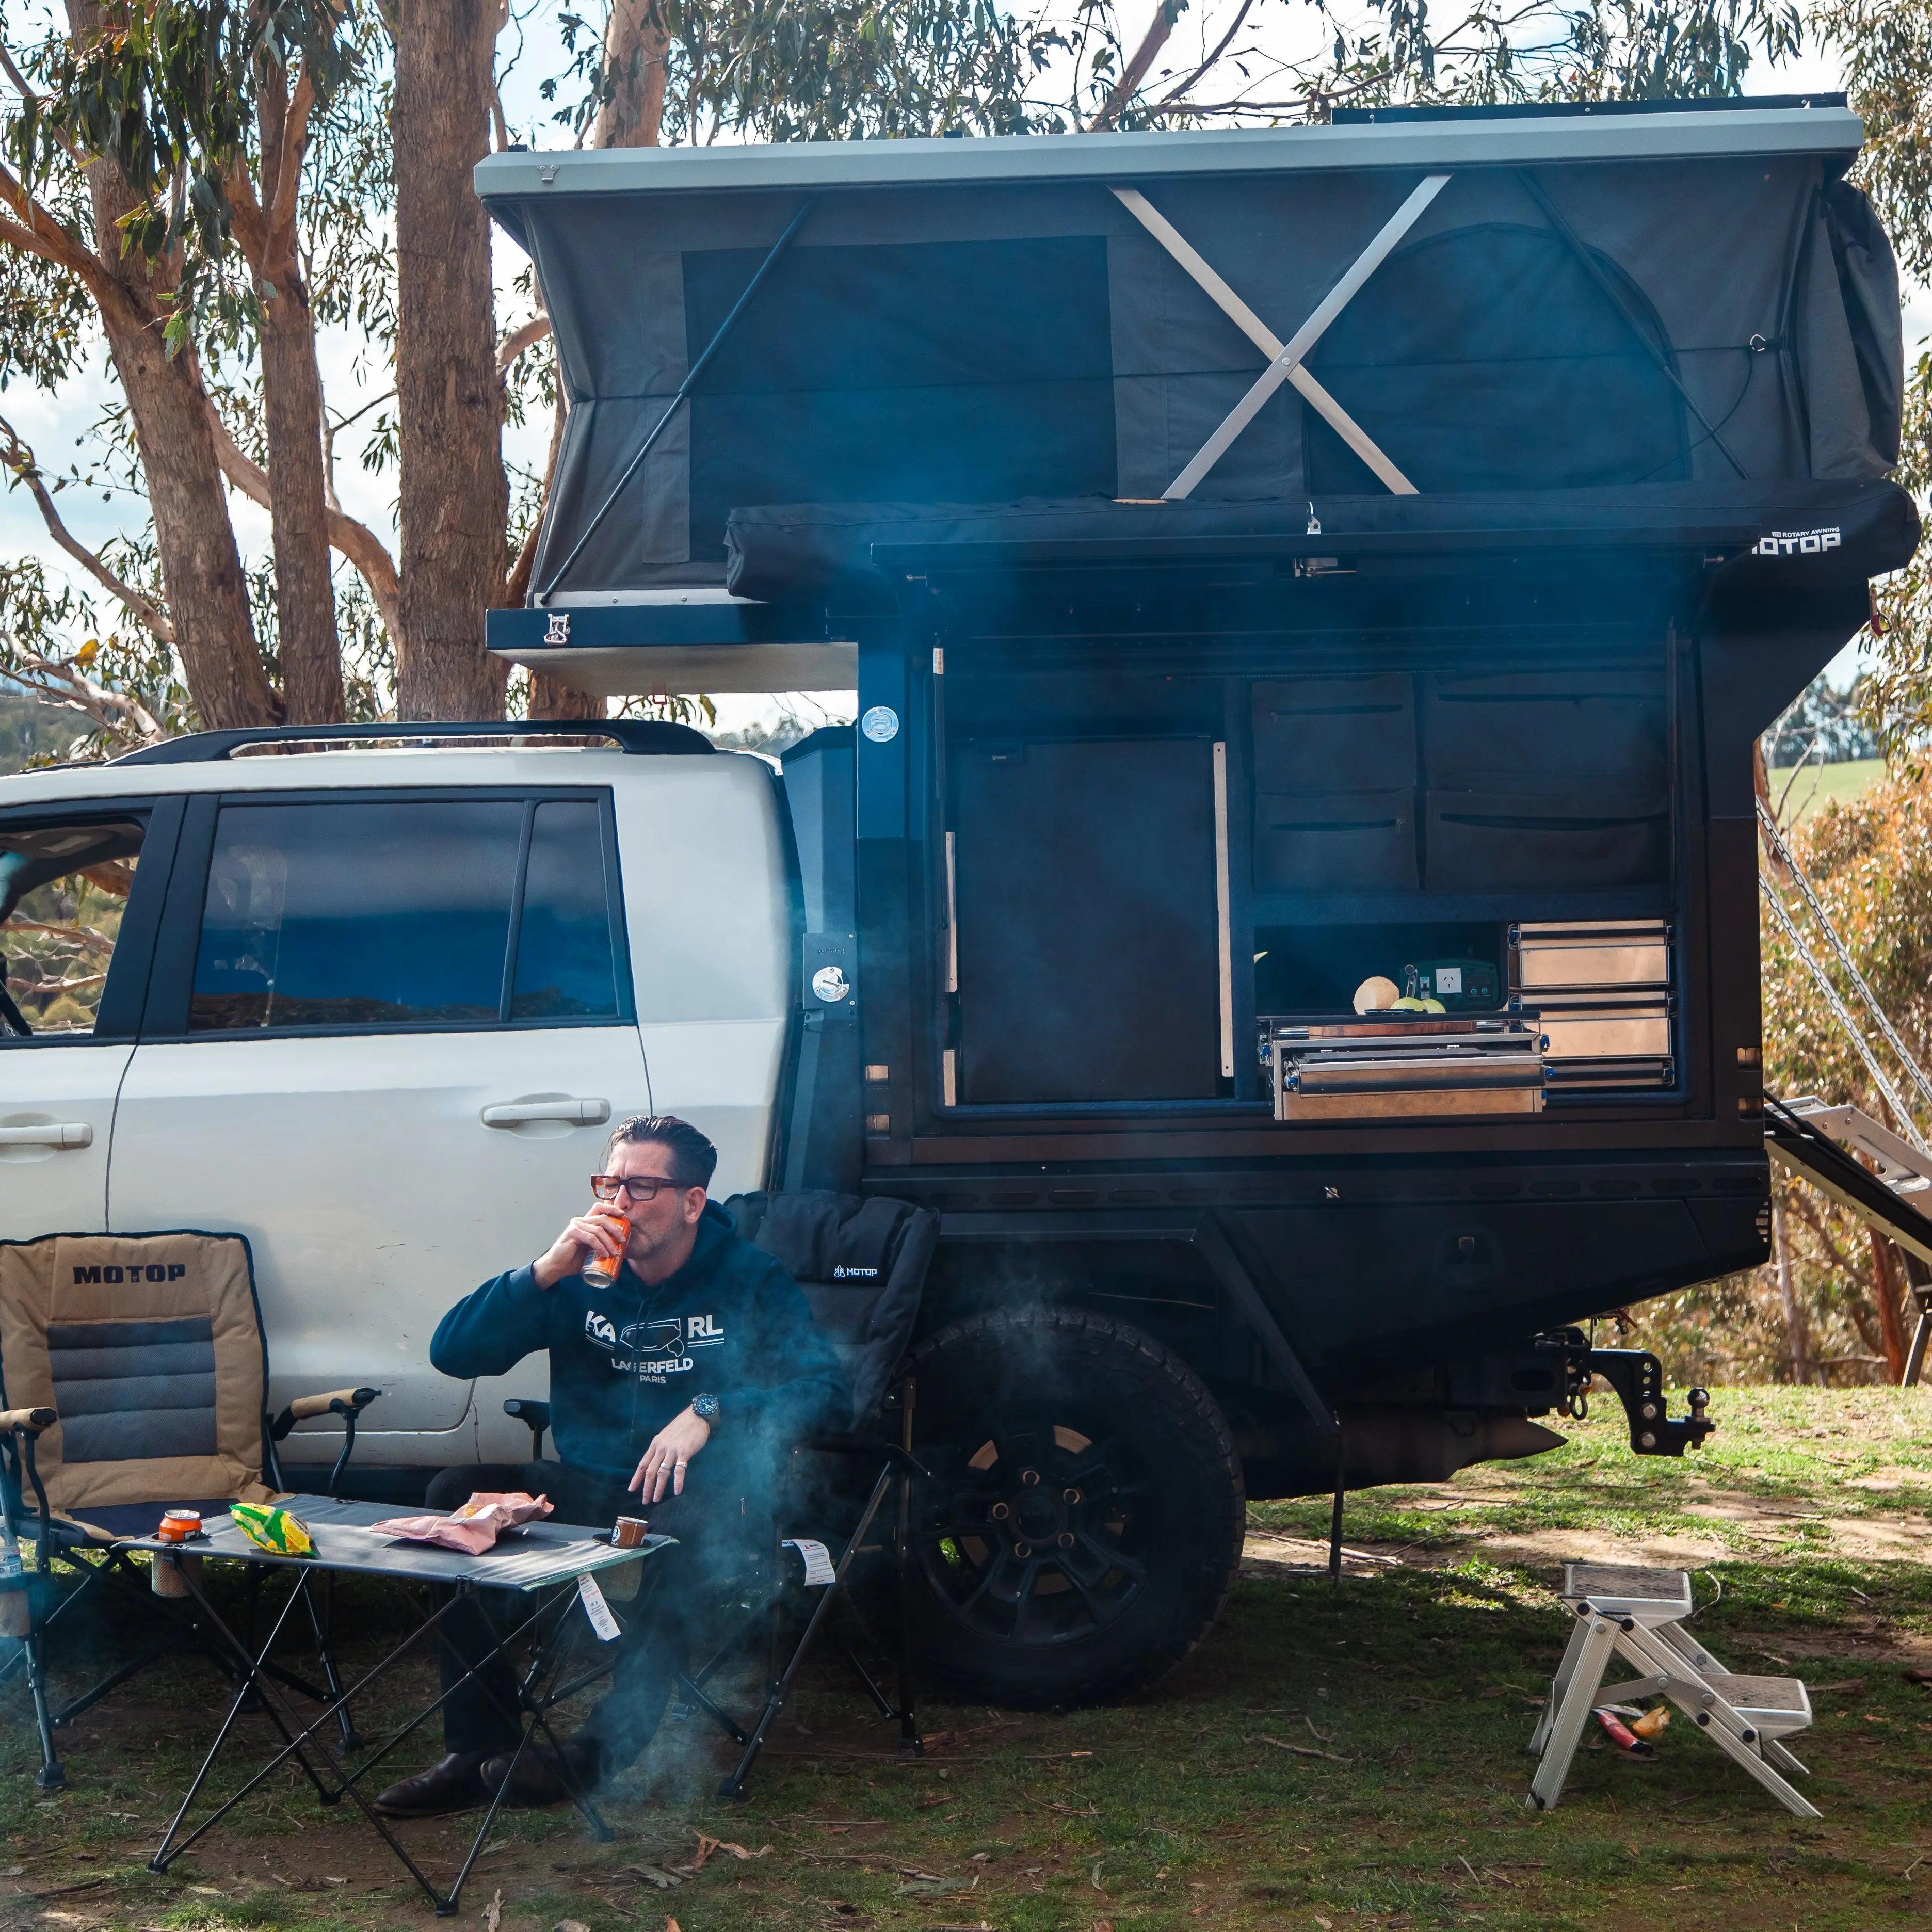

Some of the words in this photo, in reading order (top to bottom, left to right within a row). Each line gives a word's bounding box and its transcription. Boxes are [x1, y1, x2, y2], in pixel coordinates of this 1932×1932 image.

[1752, 533, 1841, 555] OTOP
[73, 1264, 185, 1284] MOTOP
[847, 1268, 877, 1276] MOTOP
[688, 1315, 723, 1338] RL
[639, 1375, 666, 1383] PARIS
